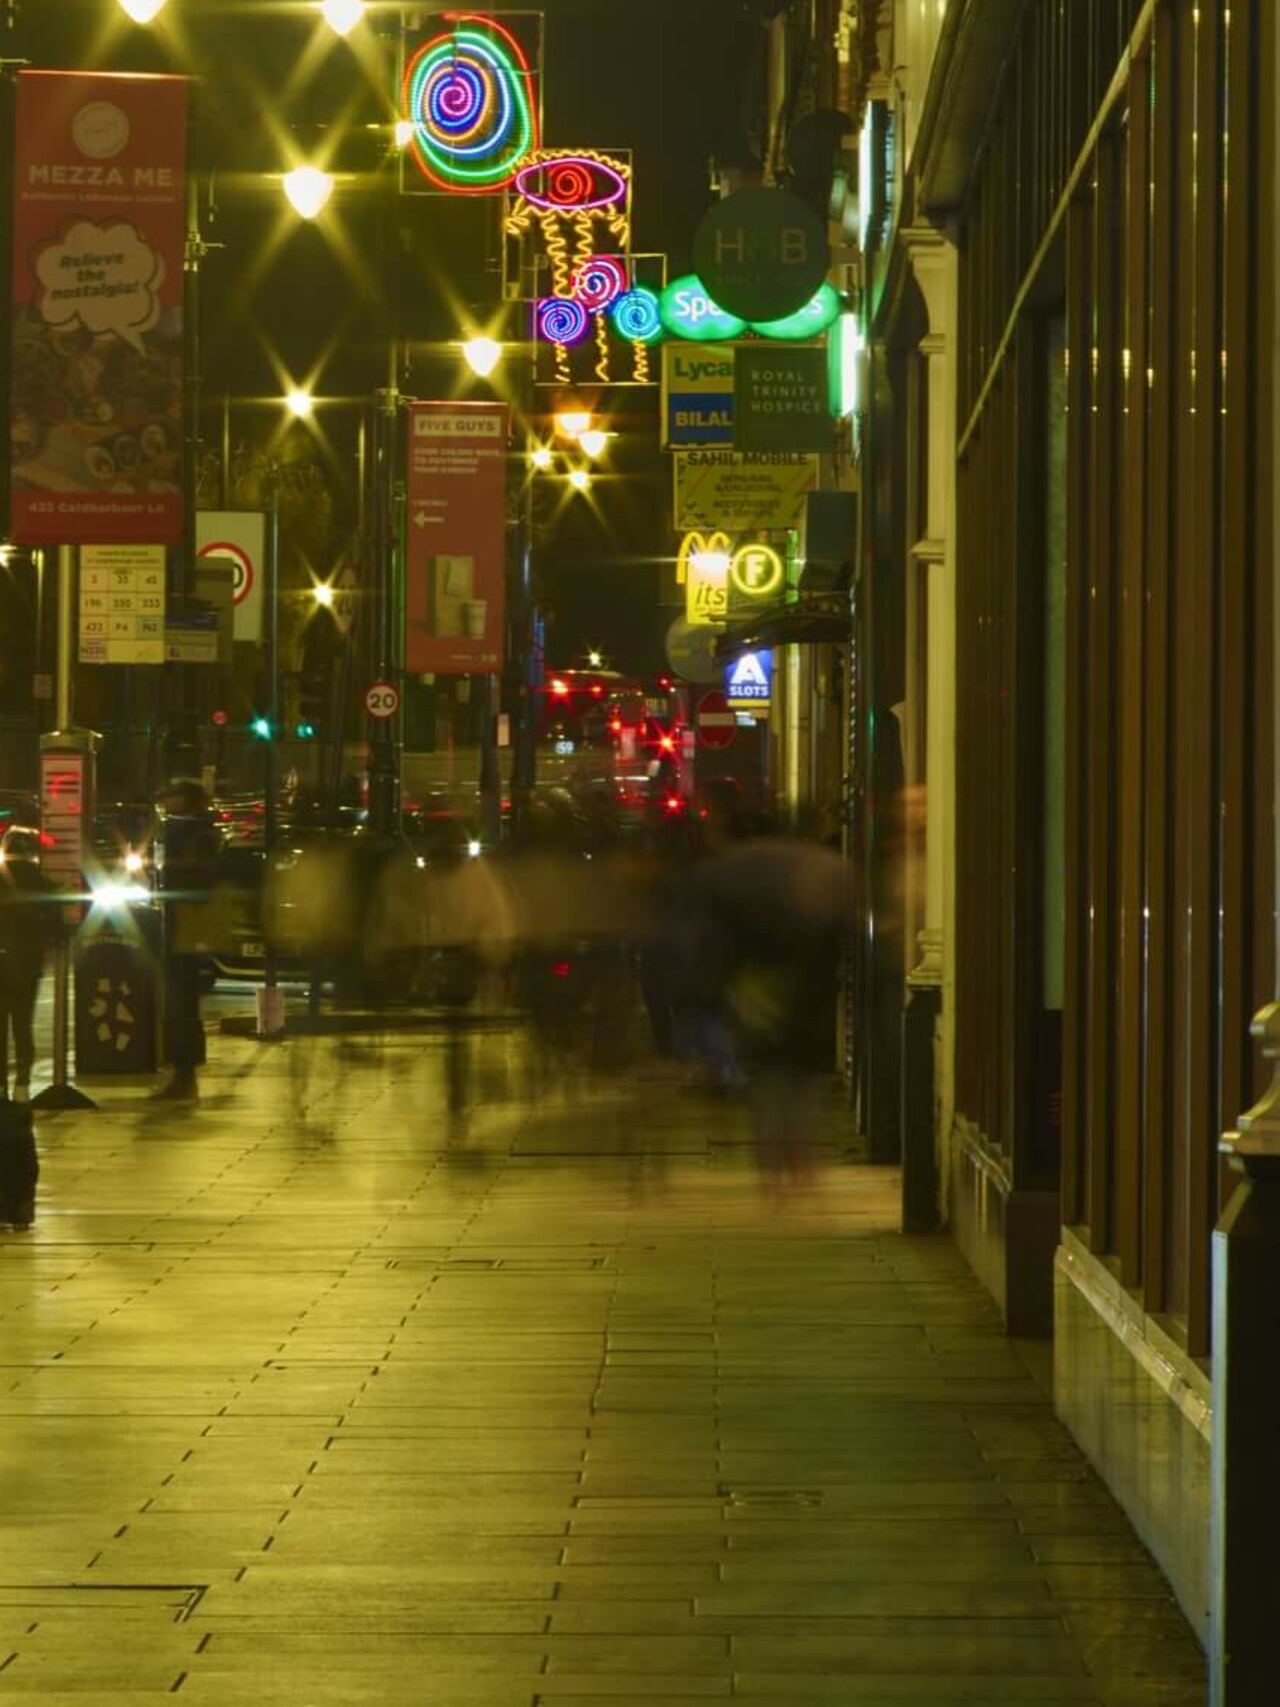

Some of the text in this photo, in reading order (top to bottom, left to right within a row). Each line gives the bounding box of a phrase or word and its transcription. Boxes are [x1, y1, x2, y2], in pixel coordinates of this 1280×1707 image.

[28, 165, 173, 187] MEZZA ME
[77, 269, 106, 282] the
[752, 371, 805, 382] ROYAL
[752, 386, 818, 398] TRINITY
[752, 401, 822, 413] HOSPICE
[419, 420, 496, 431] FIVE GUYS
[675, 411, 734, 427] BILAL
[687, 452, 809, 466] SAHIL MOBILE
[746, 553, 767, 586] F
[730, 652, 768, 684] A
[729, 685, 769, 697] SLOTS
[369, 692, 396, 709] 20
